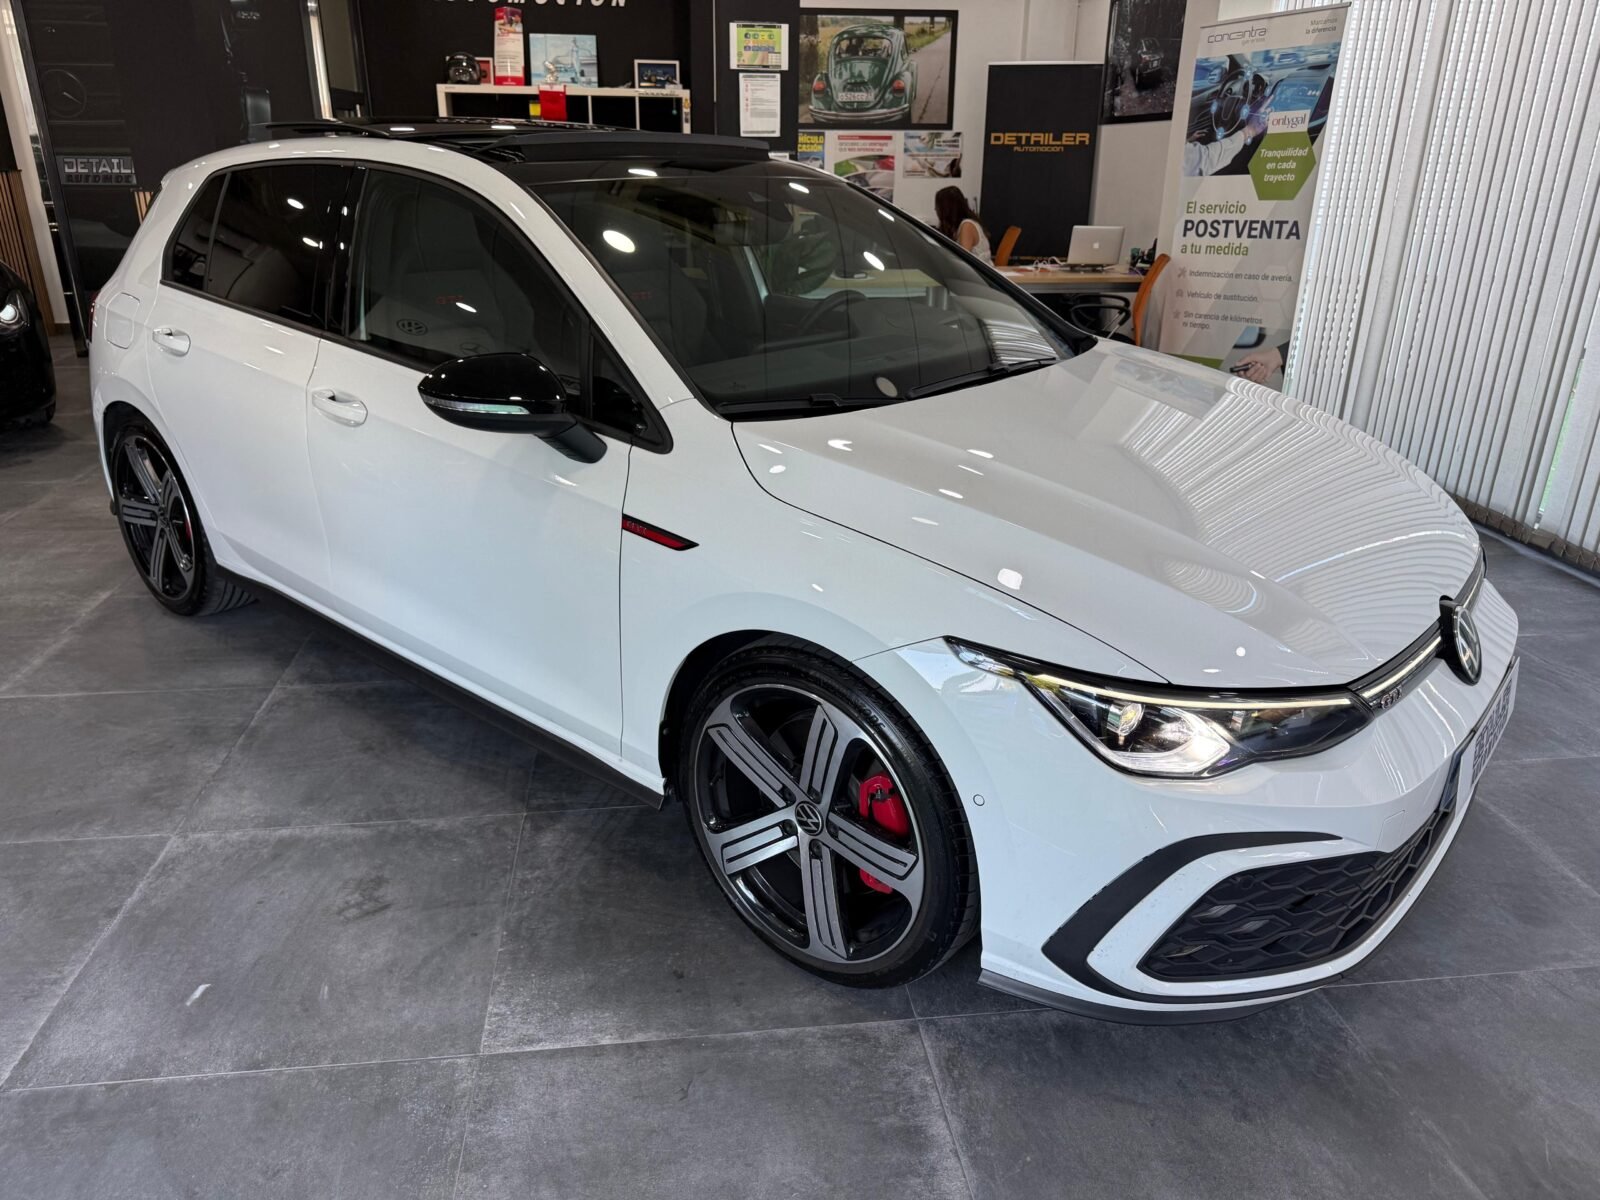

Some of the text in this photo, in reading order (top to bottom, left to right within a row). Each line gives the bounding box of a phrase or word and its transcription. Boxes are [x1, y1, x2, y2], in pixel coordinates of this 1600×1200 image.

[1311, 25, 1337, 34] diferencia
[1271, 113, 1307, 128] onlygal
[990, 132, 1090, 145] DETAILER
[1260, 147, 1309, 159] Tranquilidad
[63, 158, 135, 173] DETAIL
[1266, 160, 1297, 170] en cada
[1263, 173, 1296, 184] trayecto
[1185, 201, 1247, 215] El servicio
[1182, 219, 1301, 240] POSTVENTA
[1180, 242, 1249, 256] a tu medida
[1189, 269, 1234, 279] Indemnización
[1187, 291, 1213, 300] Vehículo
[1213, 292, 1222, 300] de
[1194, 312, 1220, 320] carencia
[1220, 313, 1229, 321] de
